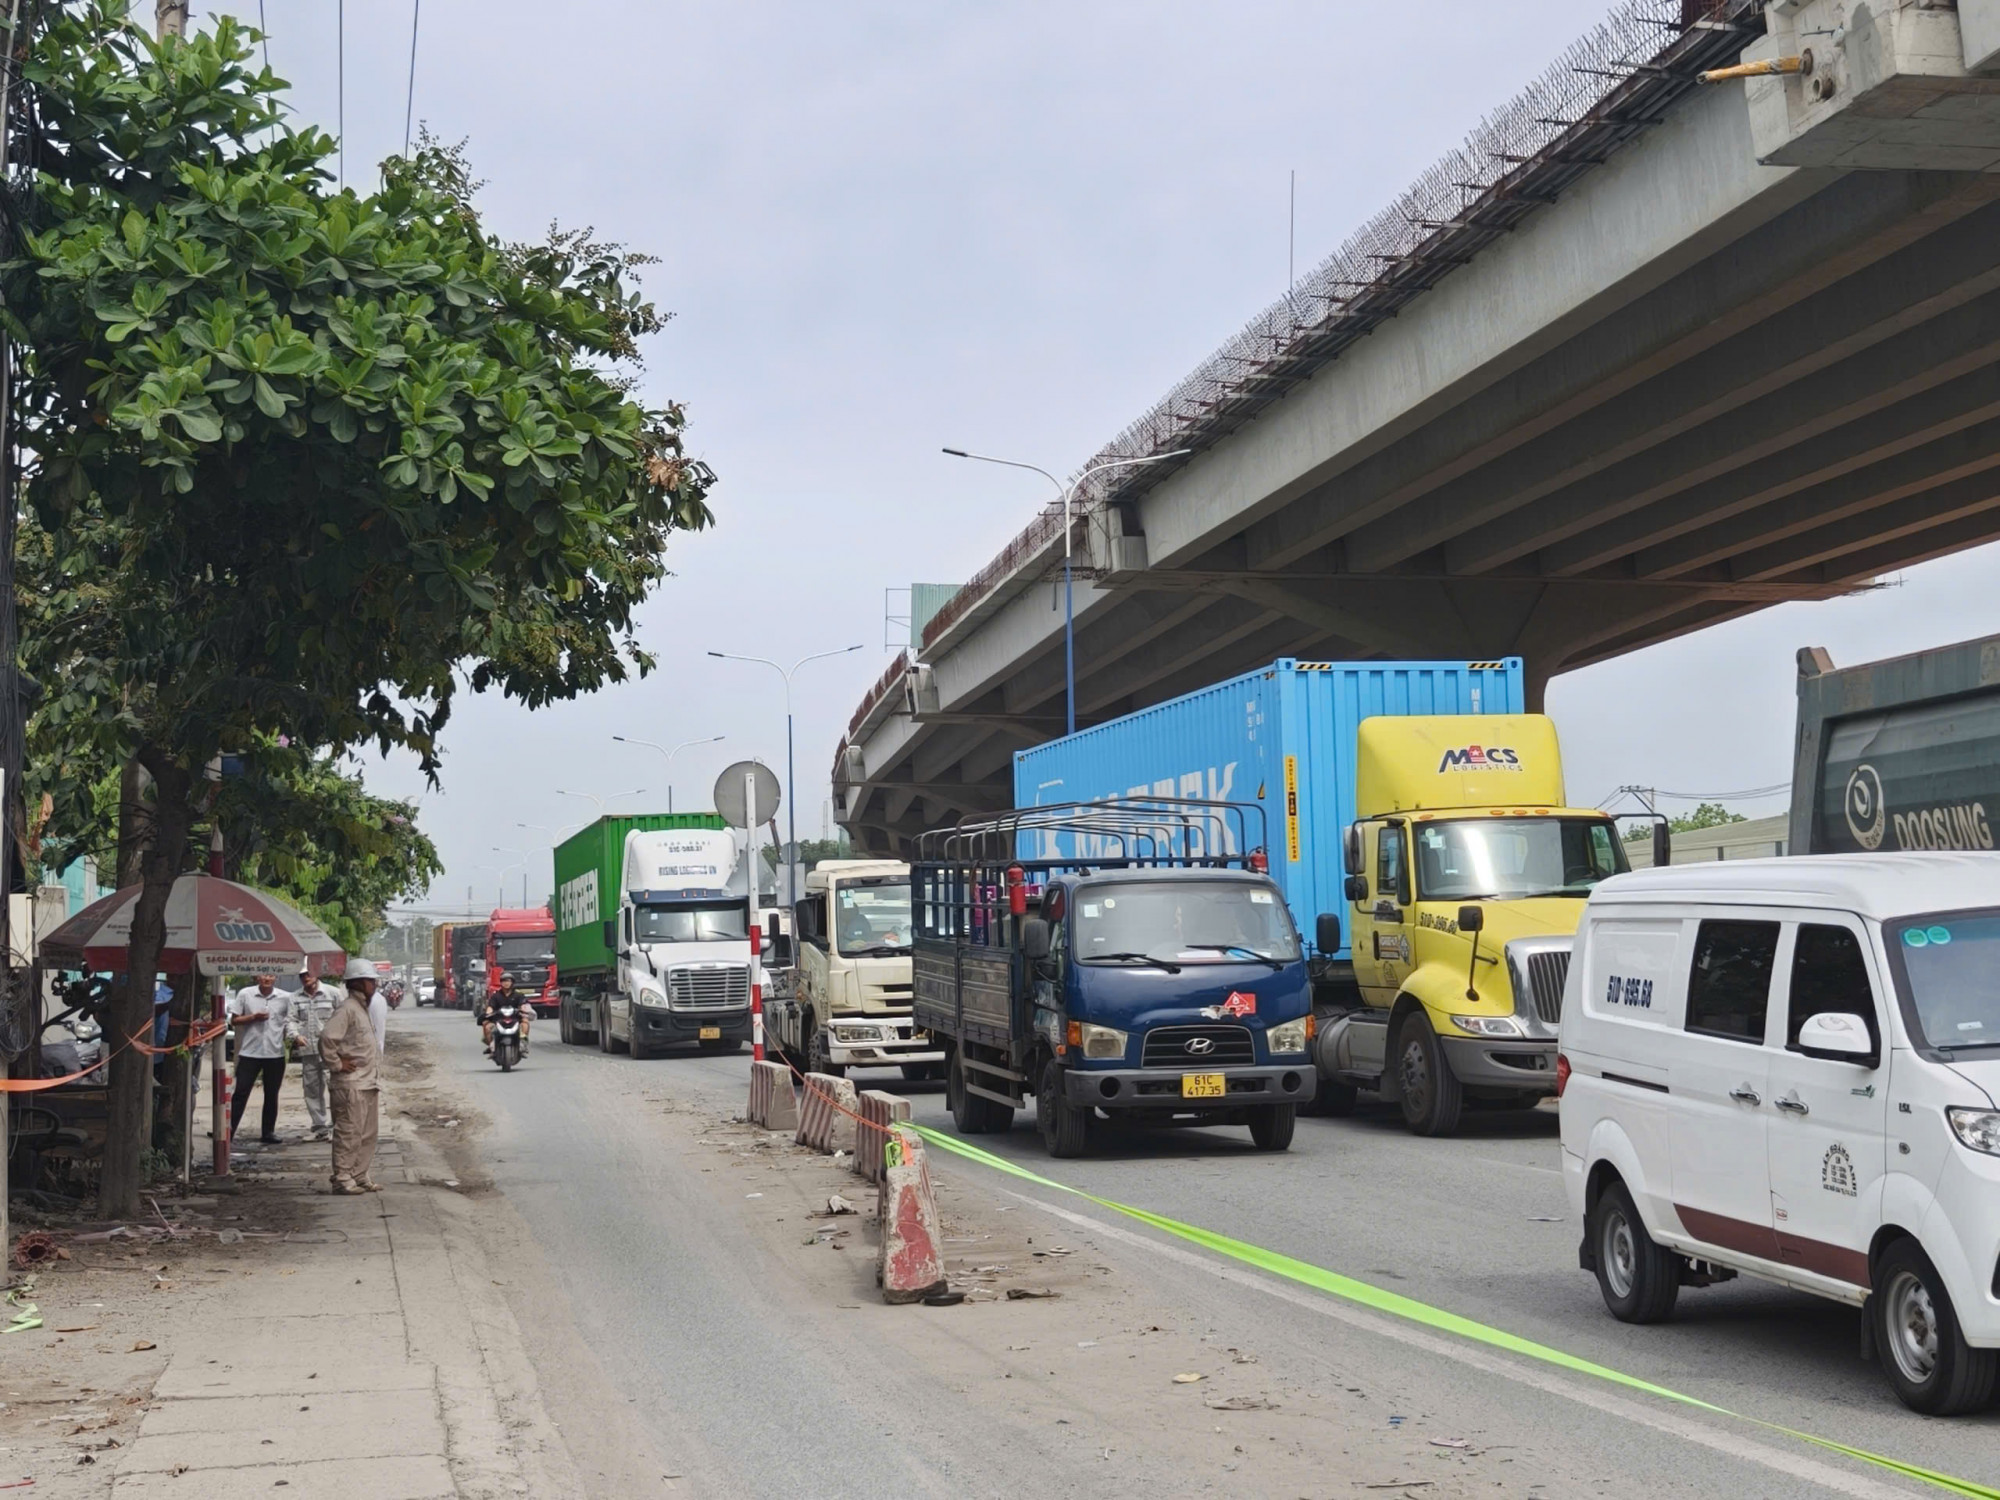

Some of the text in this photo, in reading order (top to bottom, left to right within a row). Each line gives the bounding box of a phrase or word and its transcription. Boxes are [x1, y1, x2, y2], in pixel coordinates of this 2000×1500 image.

[1453, 764, 1523, 772] LOGISTICS
[1893, 803, 1994, 850] DOOSUNG
[214, 922, 275, 943] OMO
[1194, 1075, 1213, 1085] 61C
[1187, 1085, 1221, 1096] 417.35
